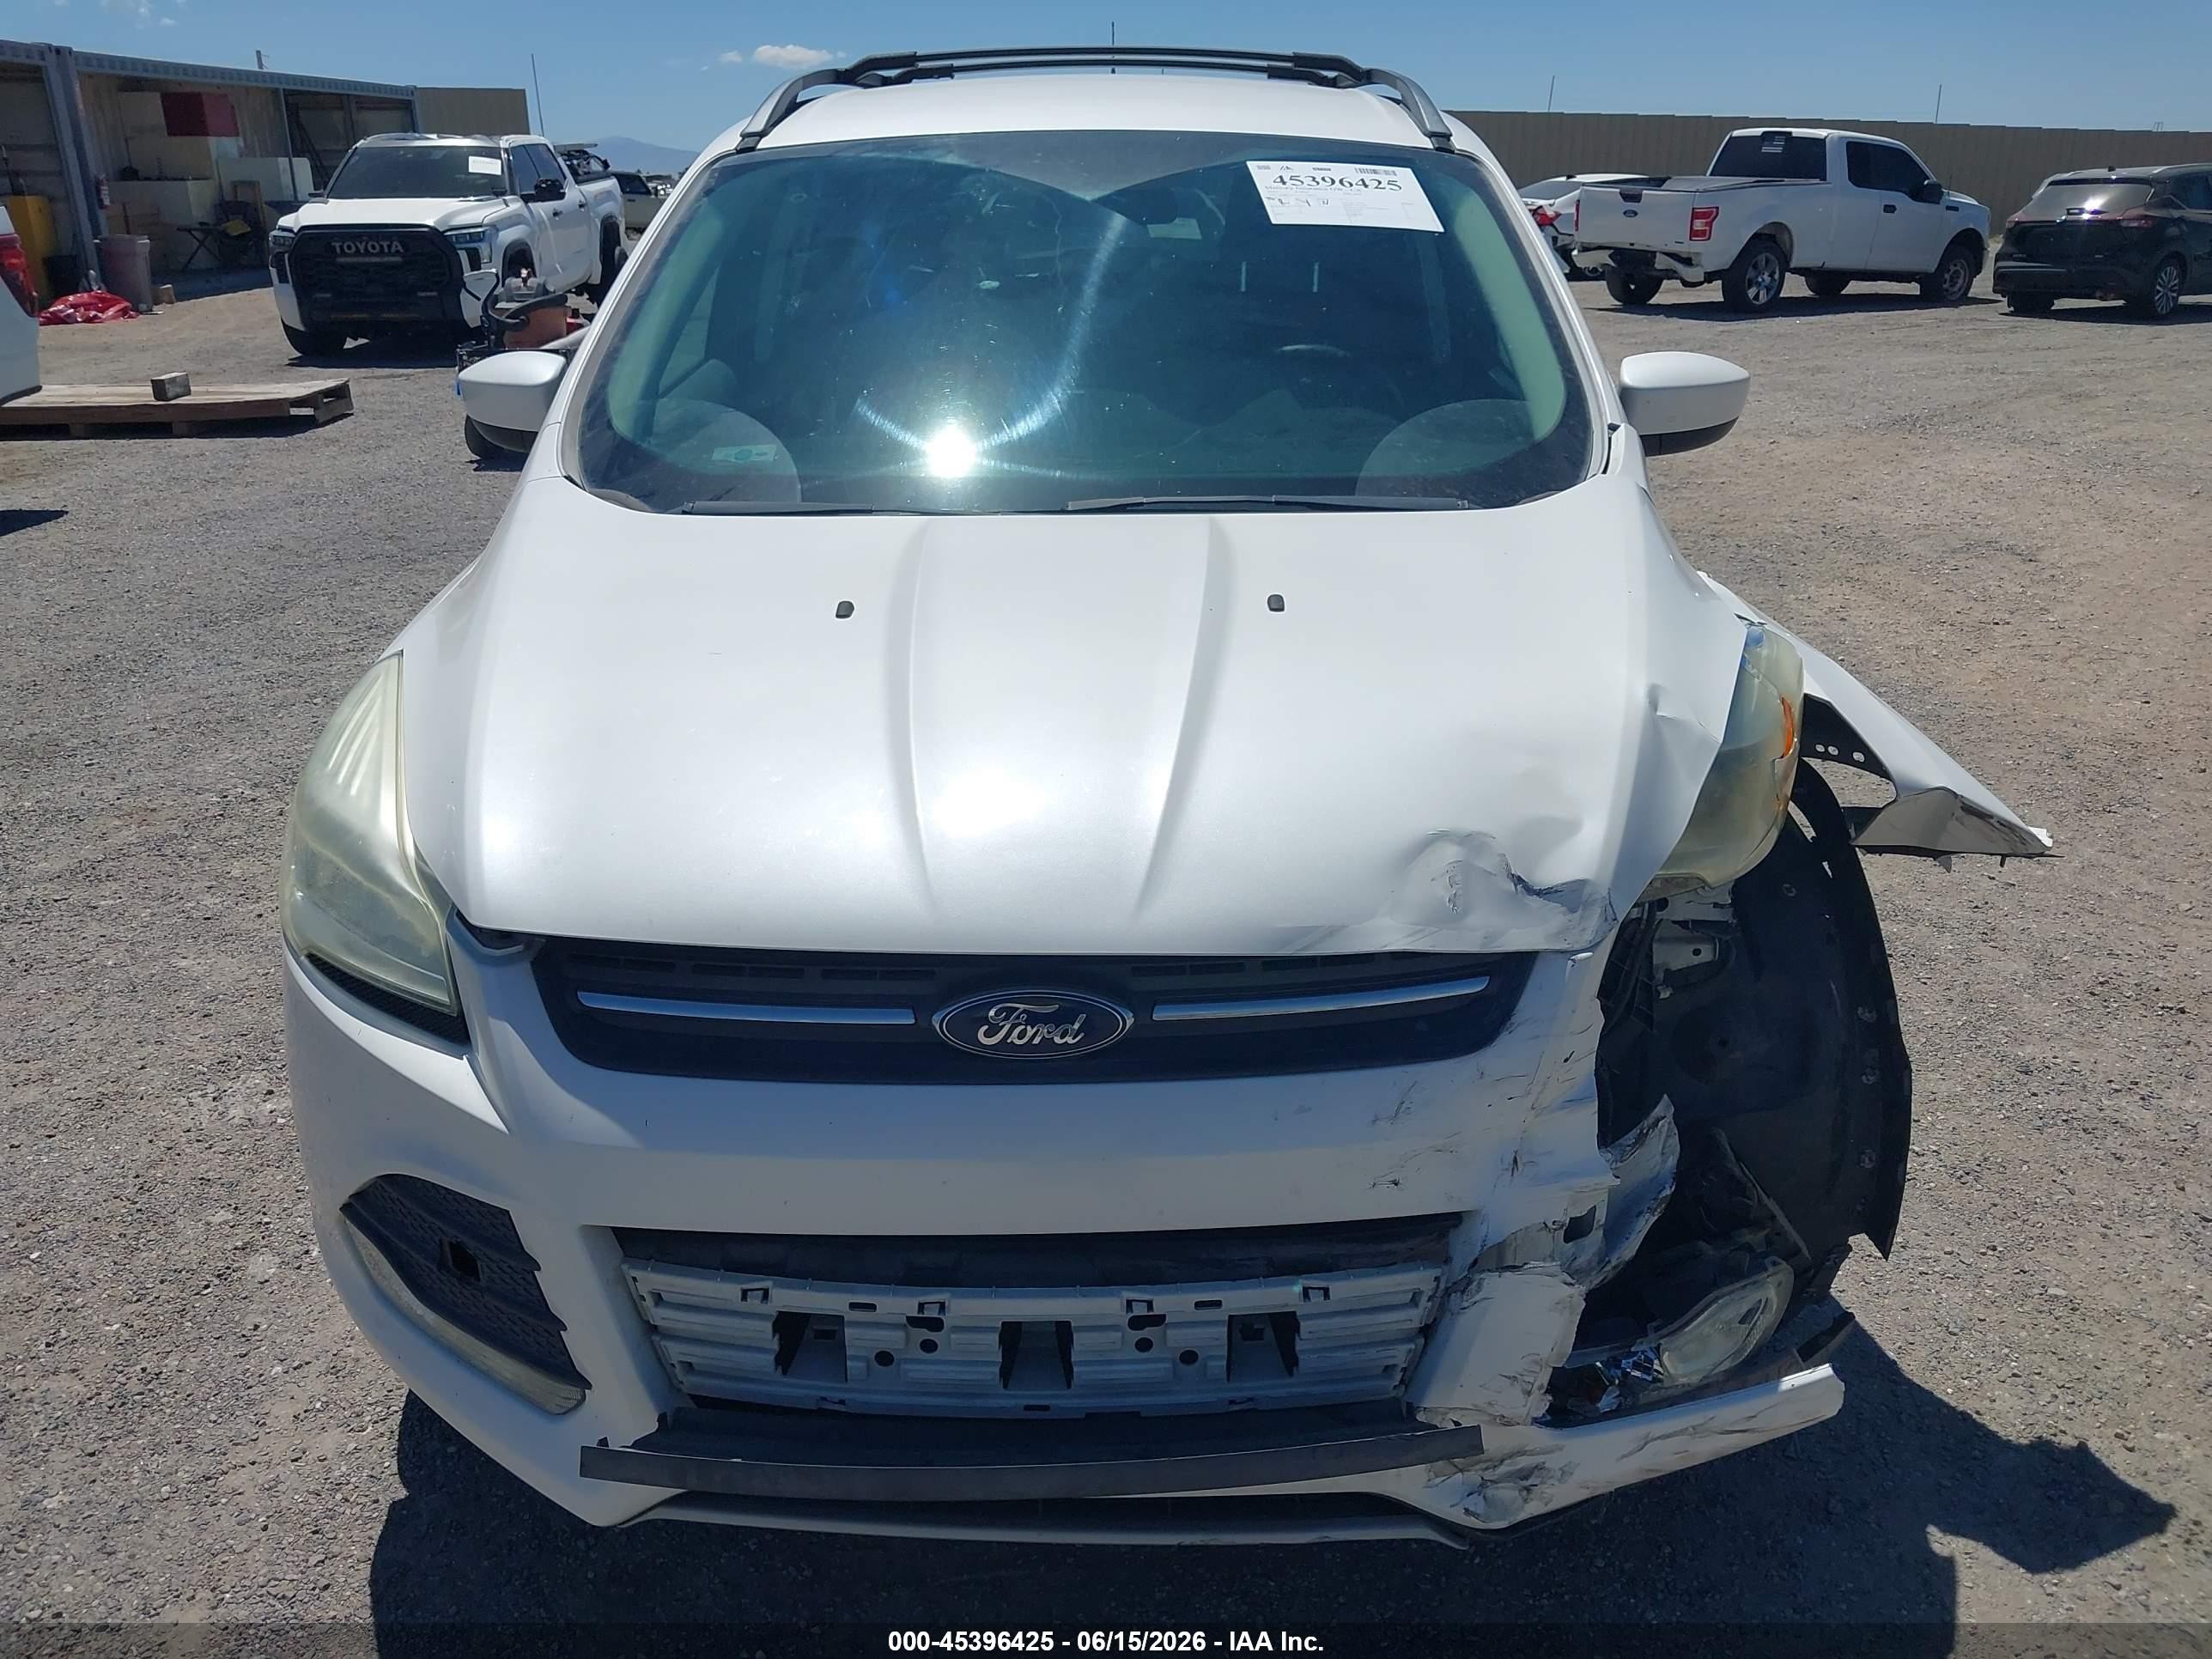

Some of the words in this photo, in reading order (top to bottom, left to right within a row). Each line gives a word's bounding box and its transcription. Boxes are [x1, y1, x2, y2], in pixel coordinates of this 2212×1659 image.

[1273, 174, 1402, 191] 45396425
[331, 240, 404, 255] TOYOTA
[977, 1003, 1086, 1046] Ford
